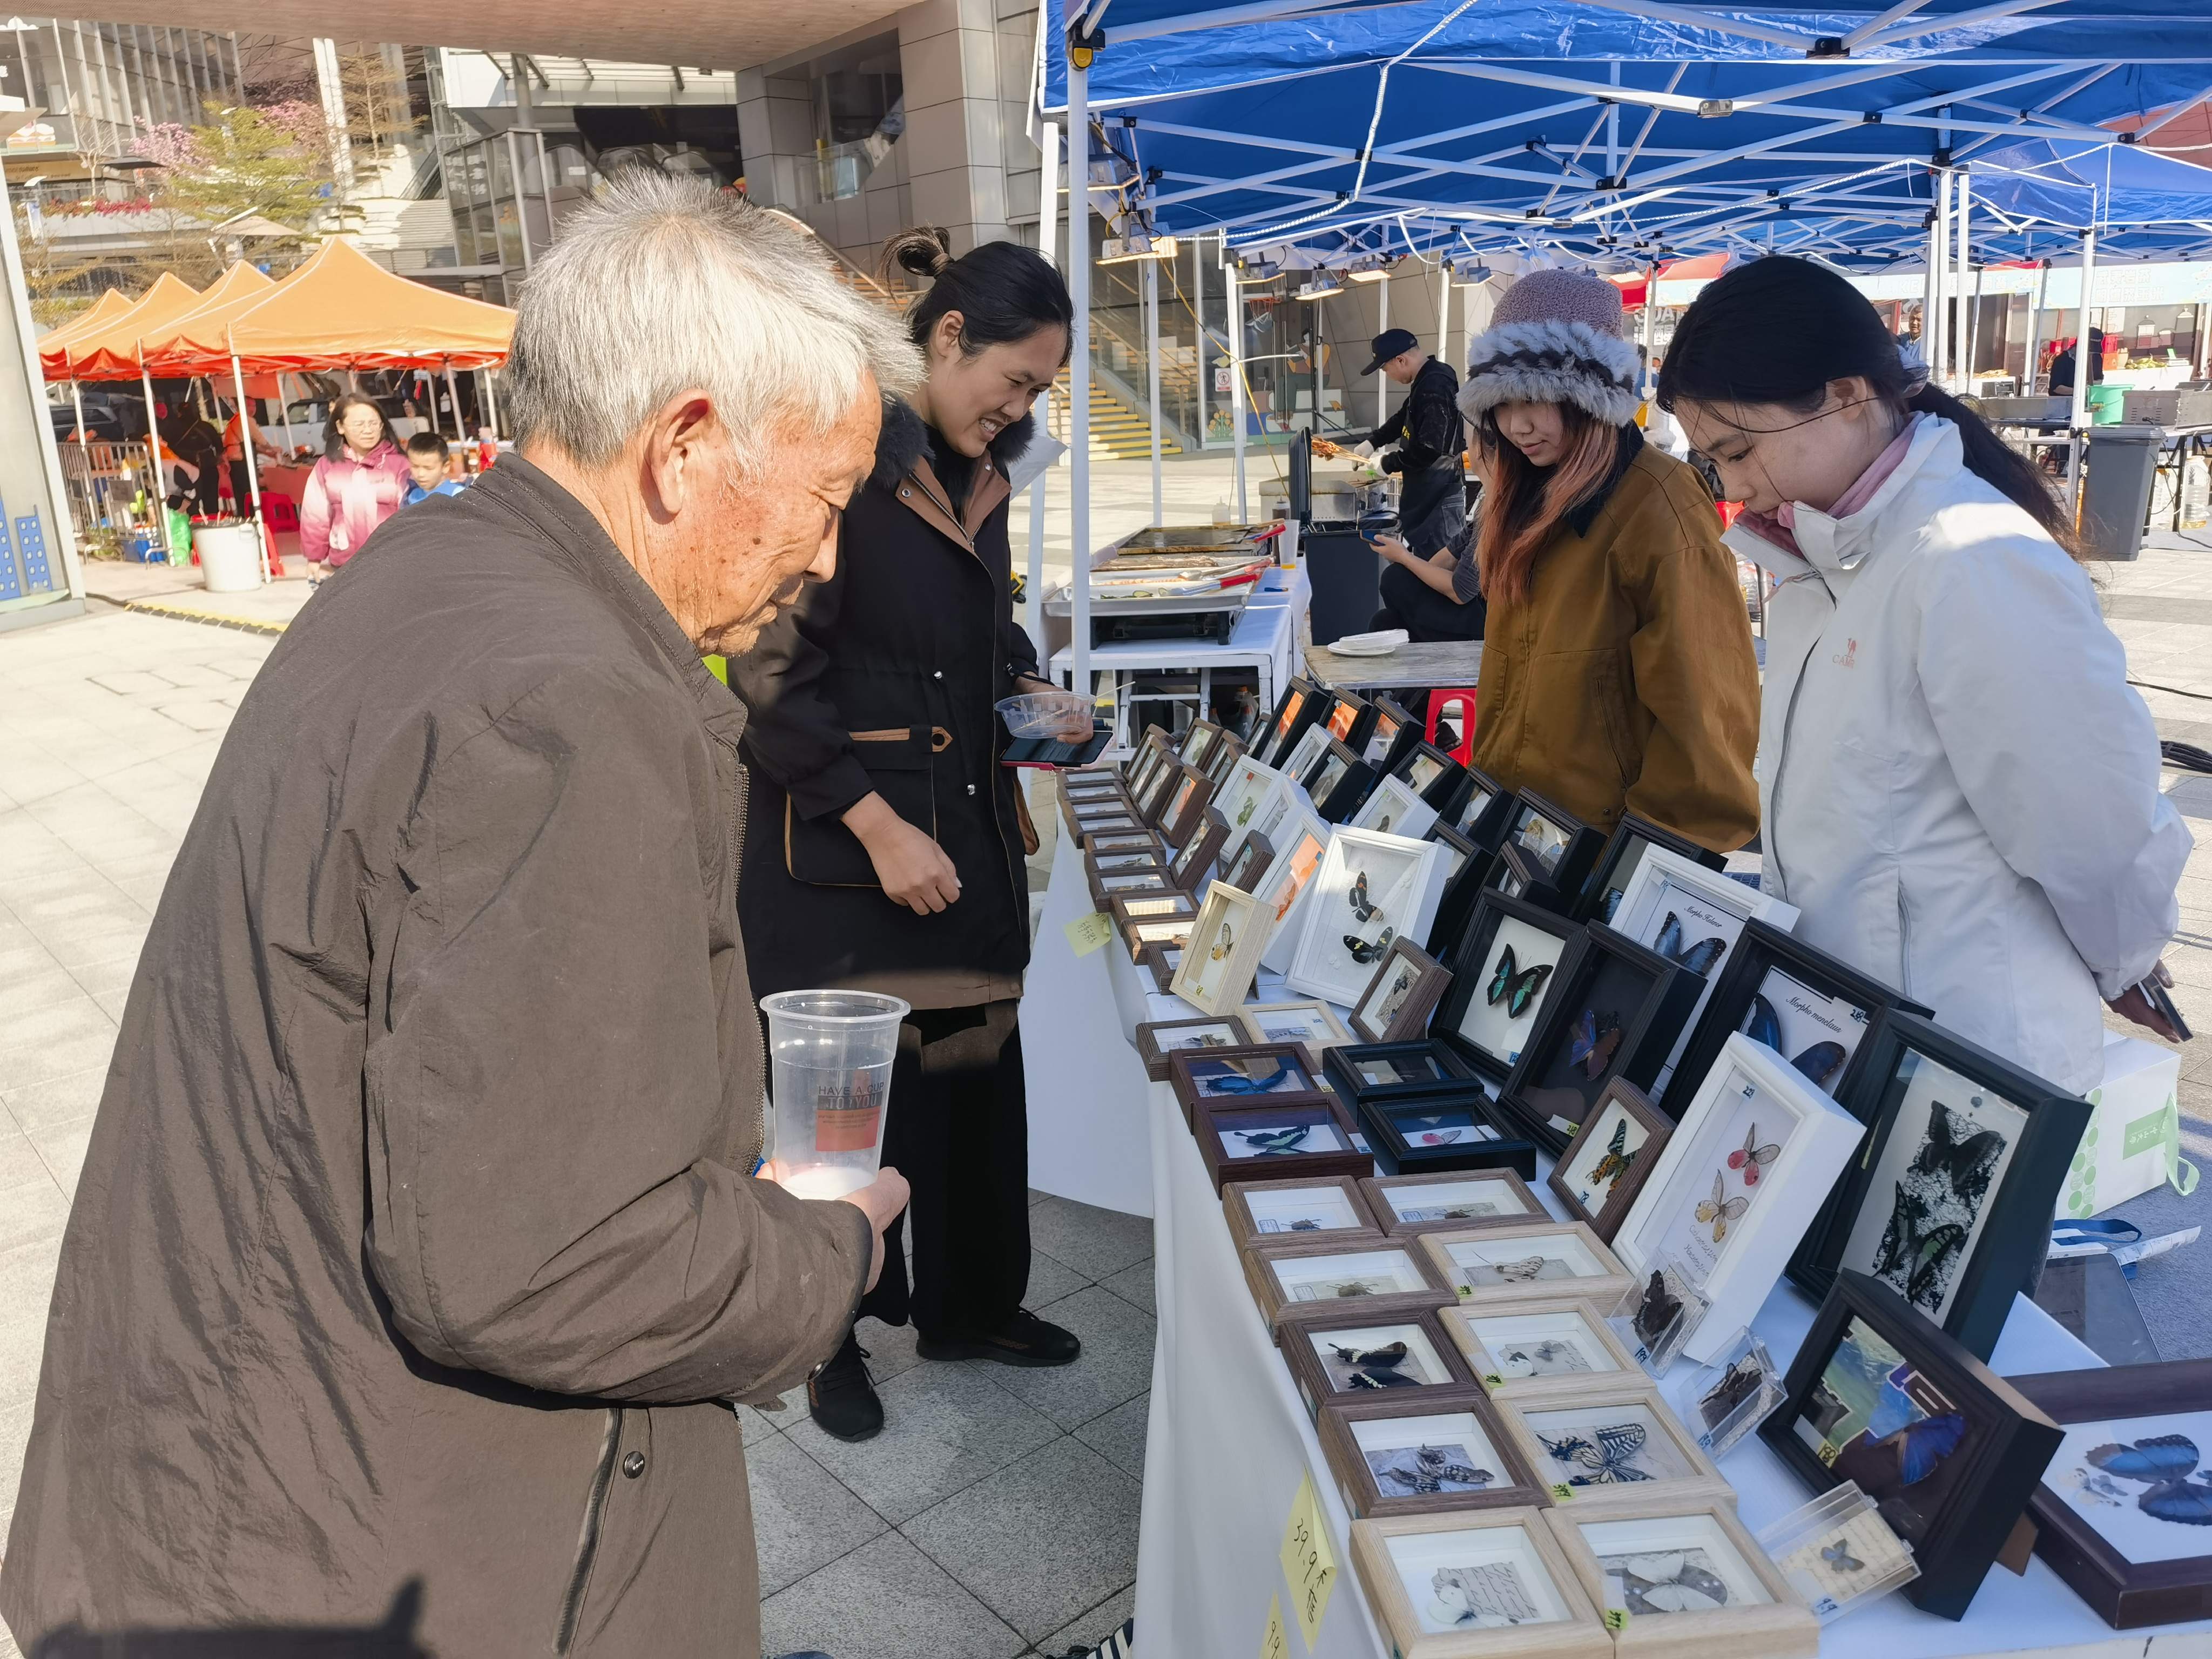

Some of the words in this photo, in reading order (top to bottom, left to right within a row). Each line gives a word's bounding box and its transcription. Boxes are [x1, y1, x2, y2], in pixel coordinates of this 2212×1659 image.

[1832, 654, 1854, 669] CAM
[1684, 906, 1703, 919] Morpho
[1785, 996, 1812, 1016] Morpho
[819, 1086, 850, 1095] HAVE
[855, 1086, 862, 1095] A
[867, 1082, 884, 1093] CUP
